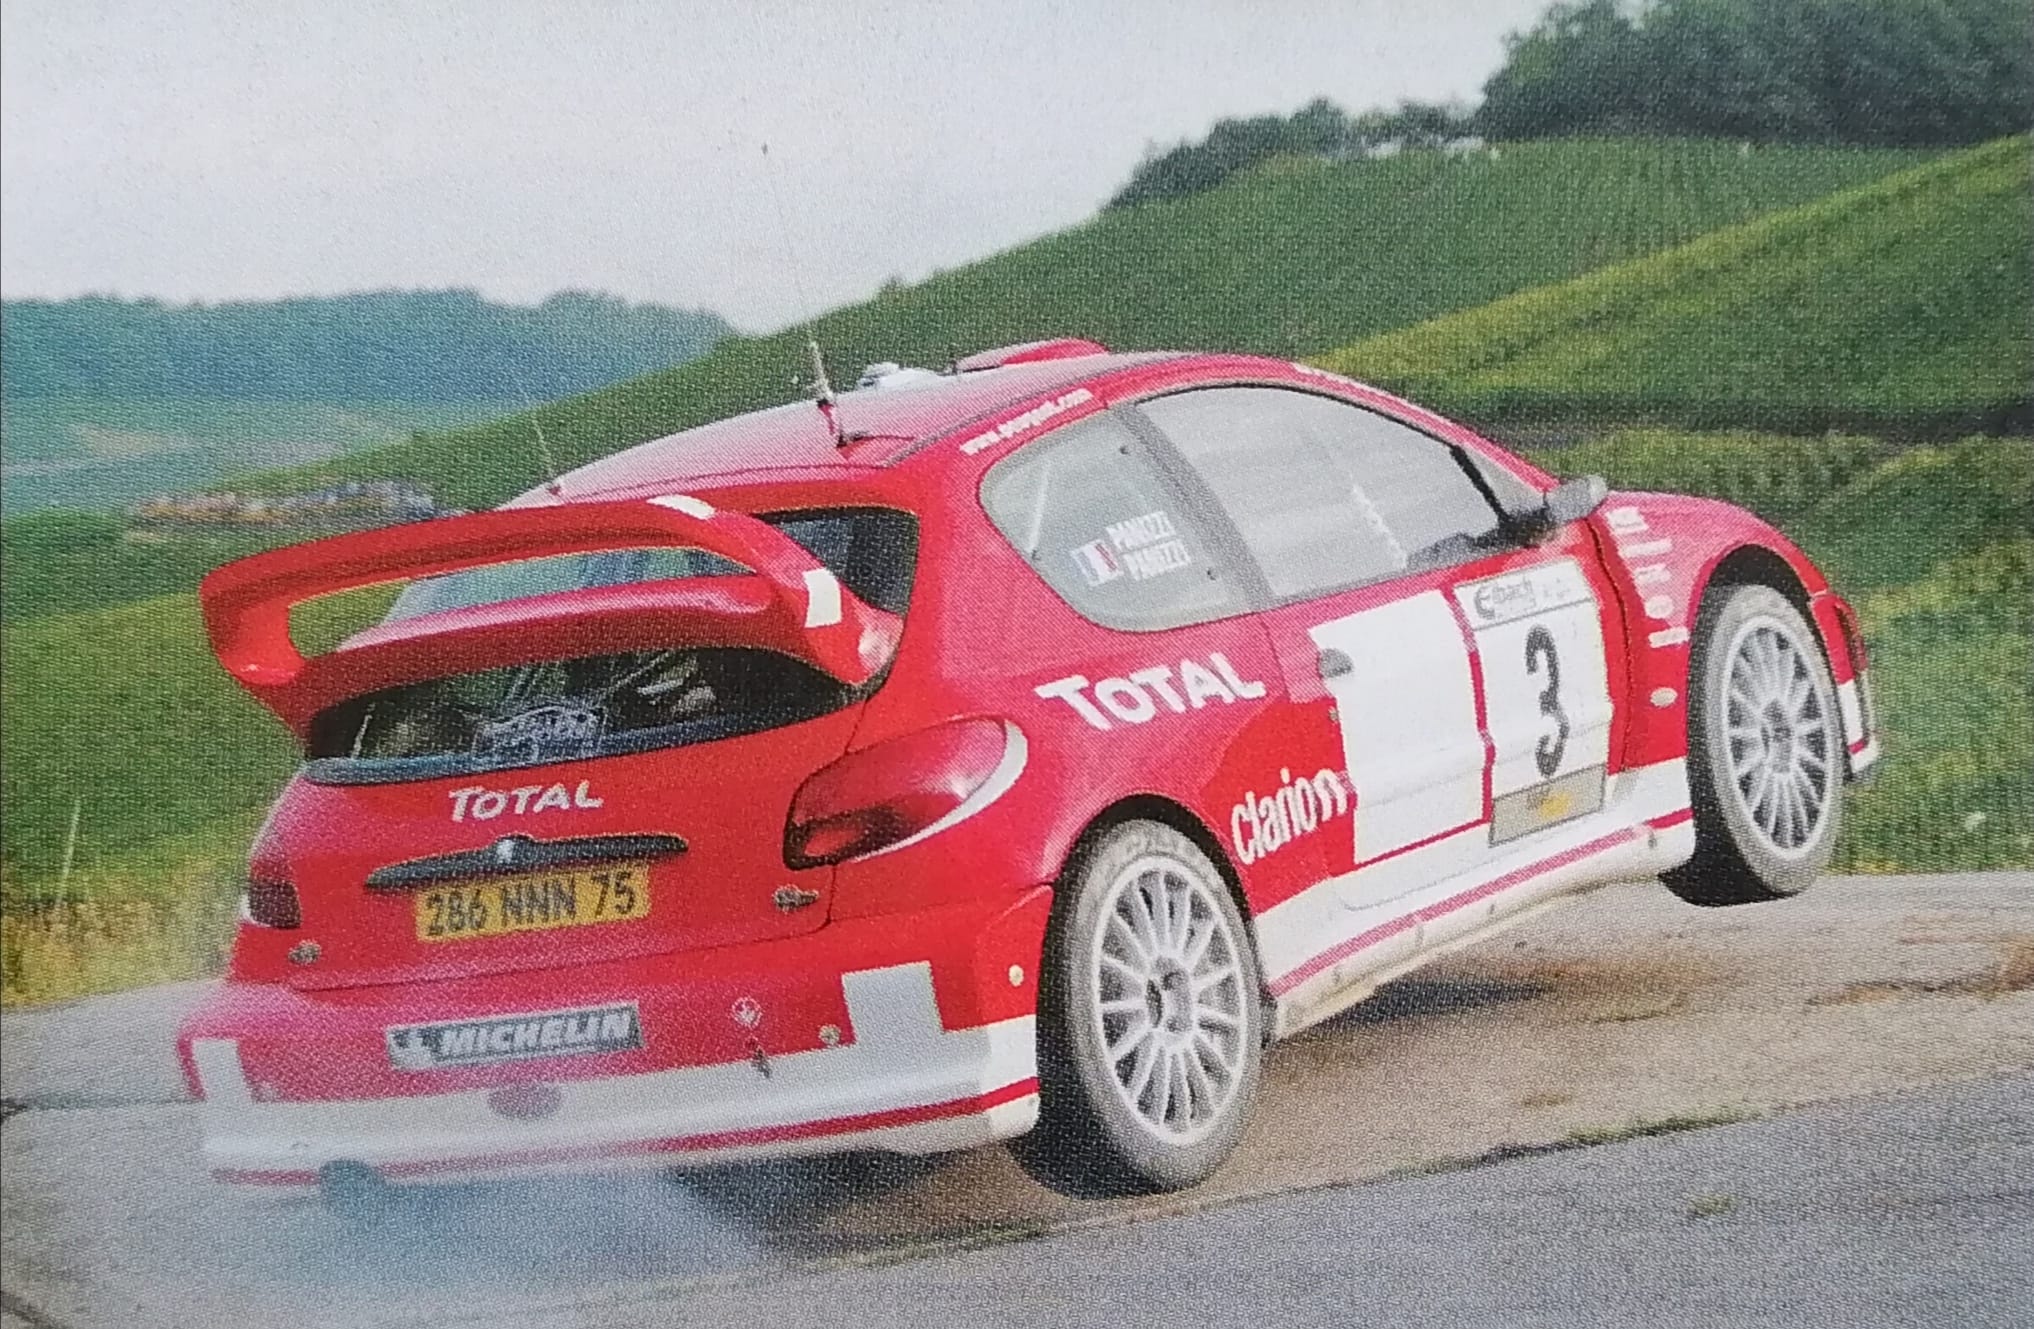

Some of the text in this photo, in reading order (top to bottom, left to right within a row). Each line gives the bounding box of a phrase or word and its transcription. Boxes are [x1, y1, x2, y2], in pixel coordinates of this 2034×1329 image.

[1034, 653, 1266, 731] TOTAL
[1525, 624, 1570, 777] 3
[449, 780, 604, 822] TOTAL
[426, 870, 635, 937] 286 NNN 75
[439, 1011, 632, 1056] MICHELIN
